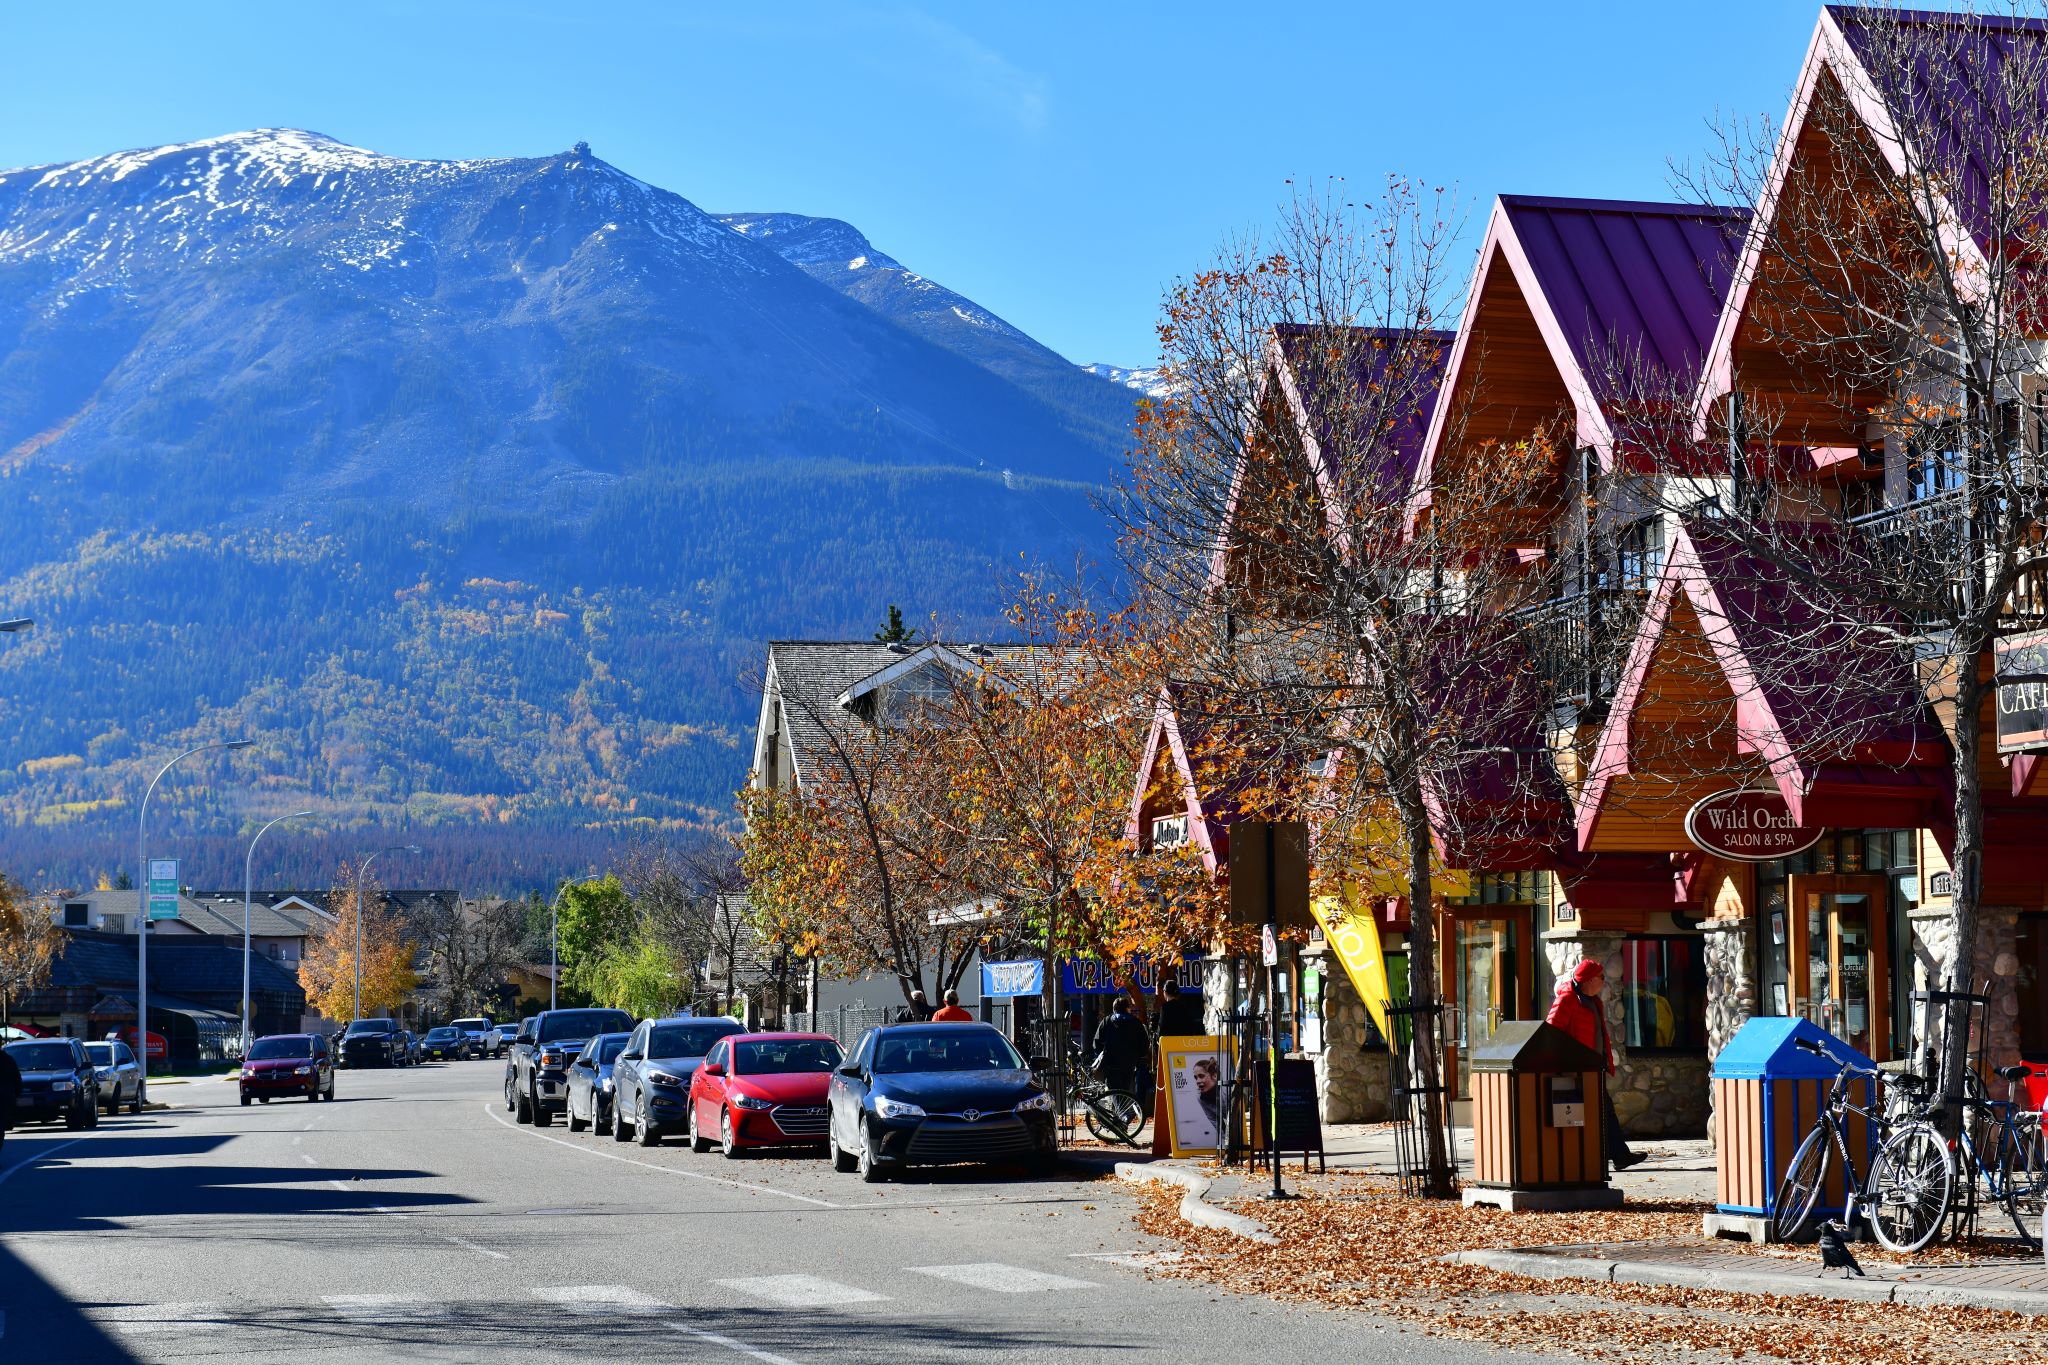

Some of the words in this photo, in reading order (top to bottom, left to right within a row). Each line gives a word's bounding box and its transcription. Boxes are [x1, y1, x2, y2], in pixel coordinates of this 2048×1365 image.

[2000, 682, 2048, 714] CAF
[1707, 803, 1748, 829] Wild
[1753, 808, 1811, 829] Orch
[1724, 833, 1760, 846] SALON
[1764, 833, 1772, 846] &
[1774, 833, 1795, 846] SPA
[1072, 960, 1097, 988] V2
[1100, 960, 1137, 988] PP
